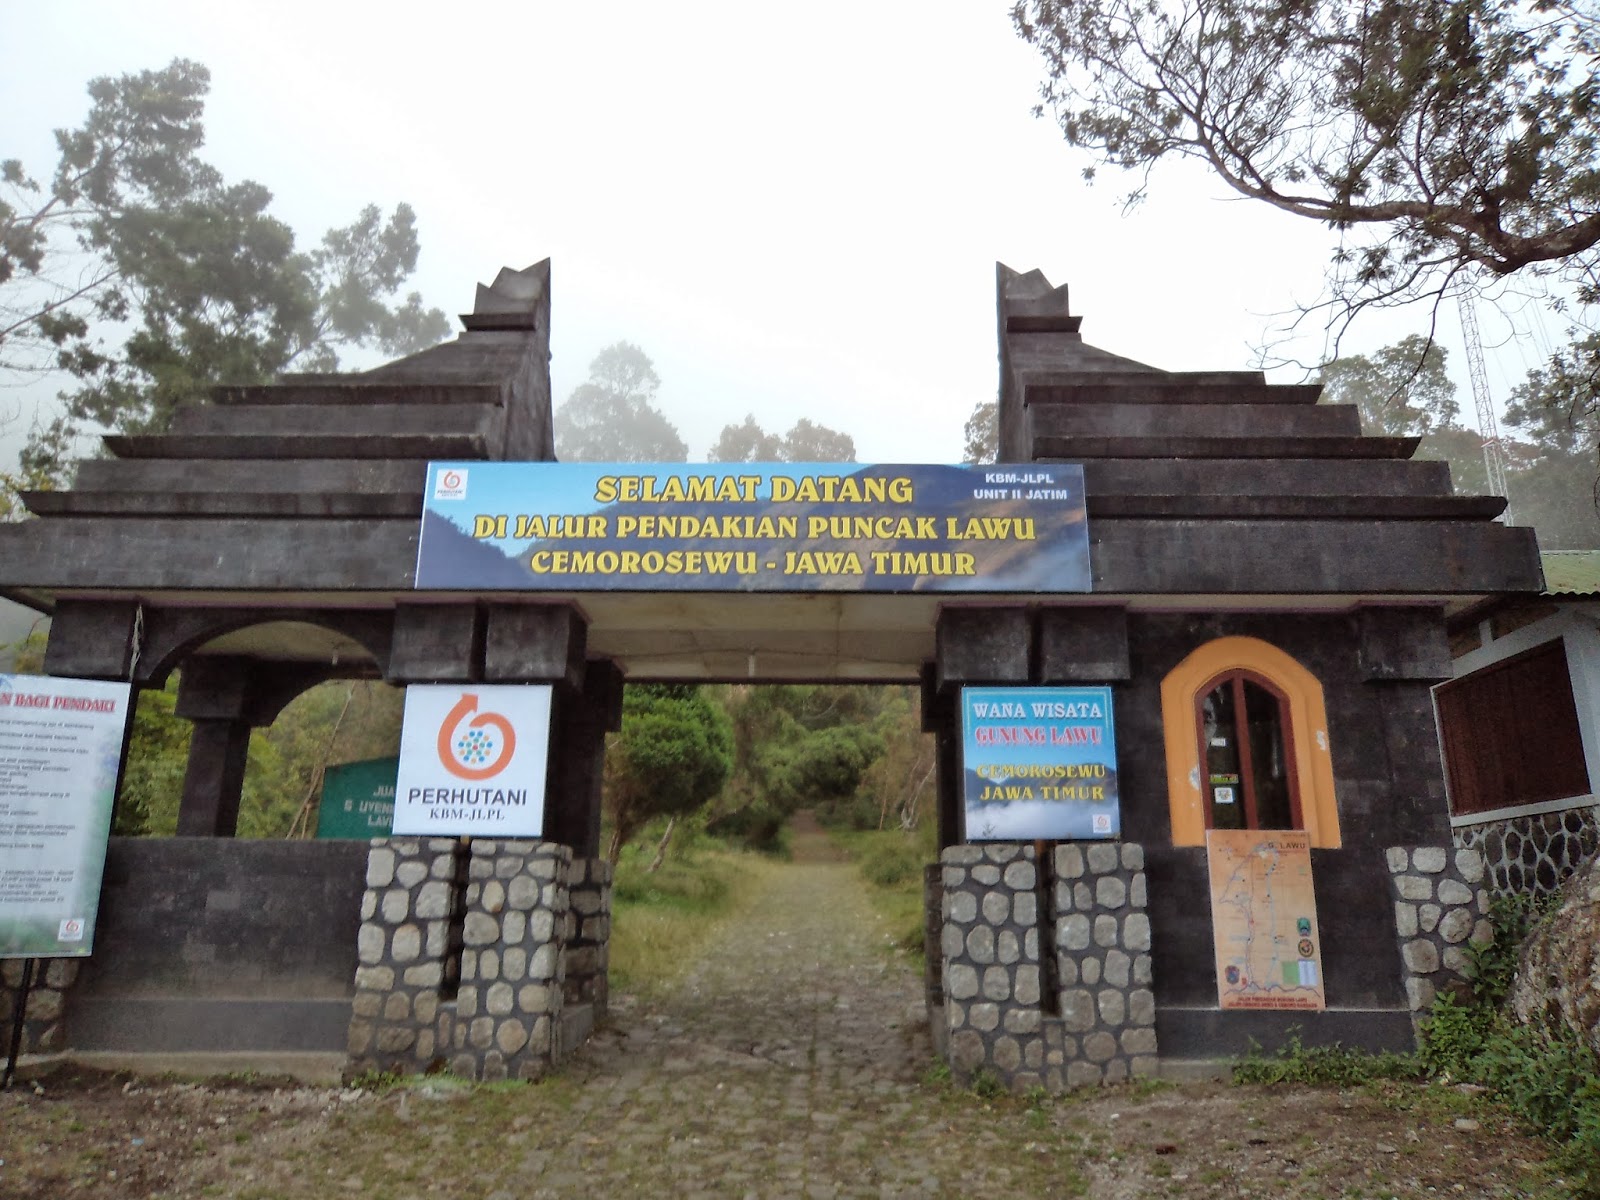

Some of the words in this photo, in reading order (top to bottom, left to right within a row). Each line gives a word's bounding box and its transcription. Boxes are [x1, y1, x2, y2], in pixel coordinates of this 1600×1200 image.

[985, 473, 1054, 484] KBM-JLPL
[595, 476, 761, 503] SELAMAT
[771, 476, 913, 503] DATANG
[974, 489, 1007, 500] UNIT
[1011, 489, 1022, 500] II
[1025, 489, 1067, 500] JATIM
[473, 515, 508, 538] DI
[514, 515, 607, 538] JALUR
[616, 515, 798, 539] PENDAKIAN
[807, 516, 938, 540] PUNCAK
[946, 517, 1036, 540] LAWU
[531, 550, 758, 574] CEMOROSEWU
[784, 551, 863, 575] JAWA
[870, 552, 976, 575] TIMUR
[14, 693, 50, 709] BAGI
[52, 696, 115, 713] PENDAKI
[973, 702, 1027, 719] WANA
[1031, 702, 1103, 719] WISATA
[975, 726, 1046, 746] GUNUNG
[1050, 726, 1103, 746] LAWU
[976, 764, 1105, 779] CEMOROSEWU
[408, 788, 527, 806] PERHUTANI
[980, 786, 1034, 801] JAWA
[1040, 786, 1105, 801] TIMUR
[430, 808, 505, 821] KBM-JLPL
